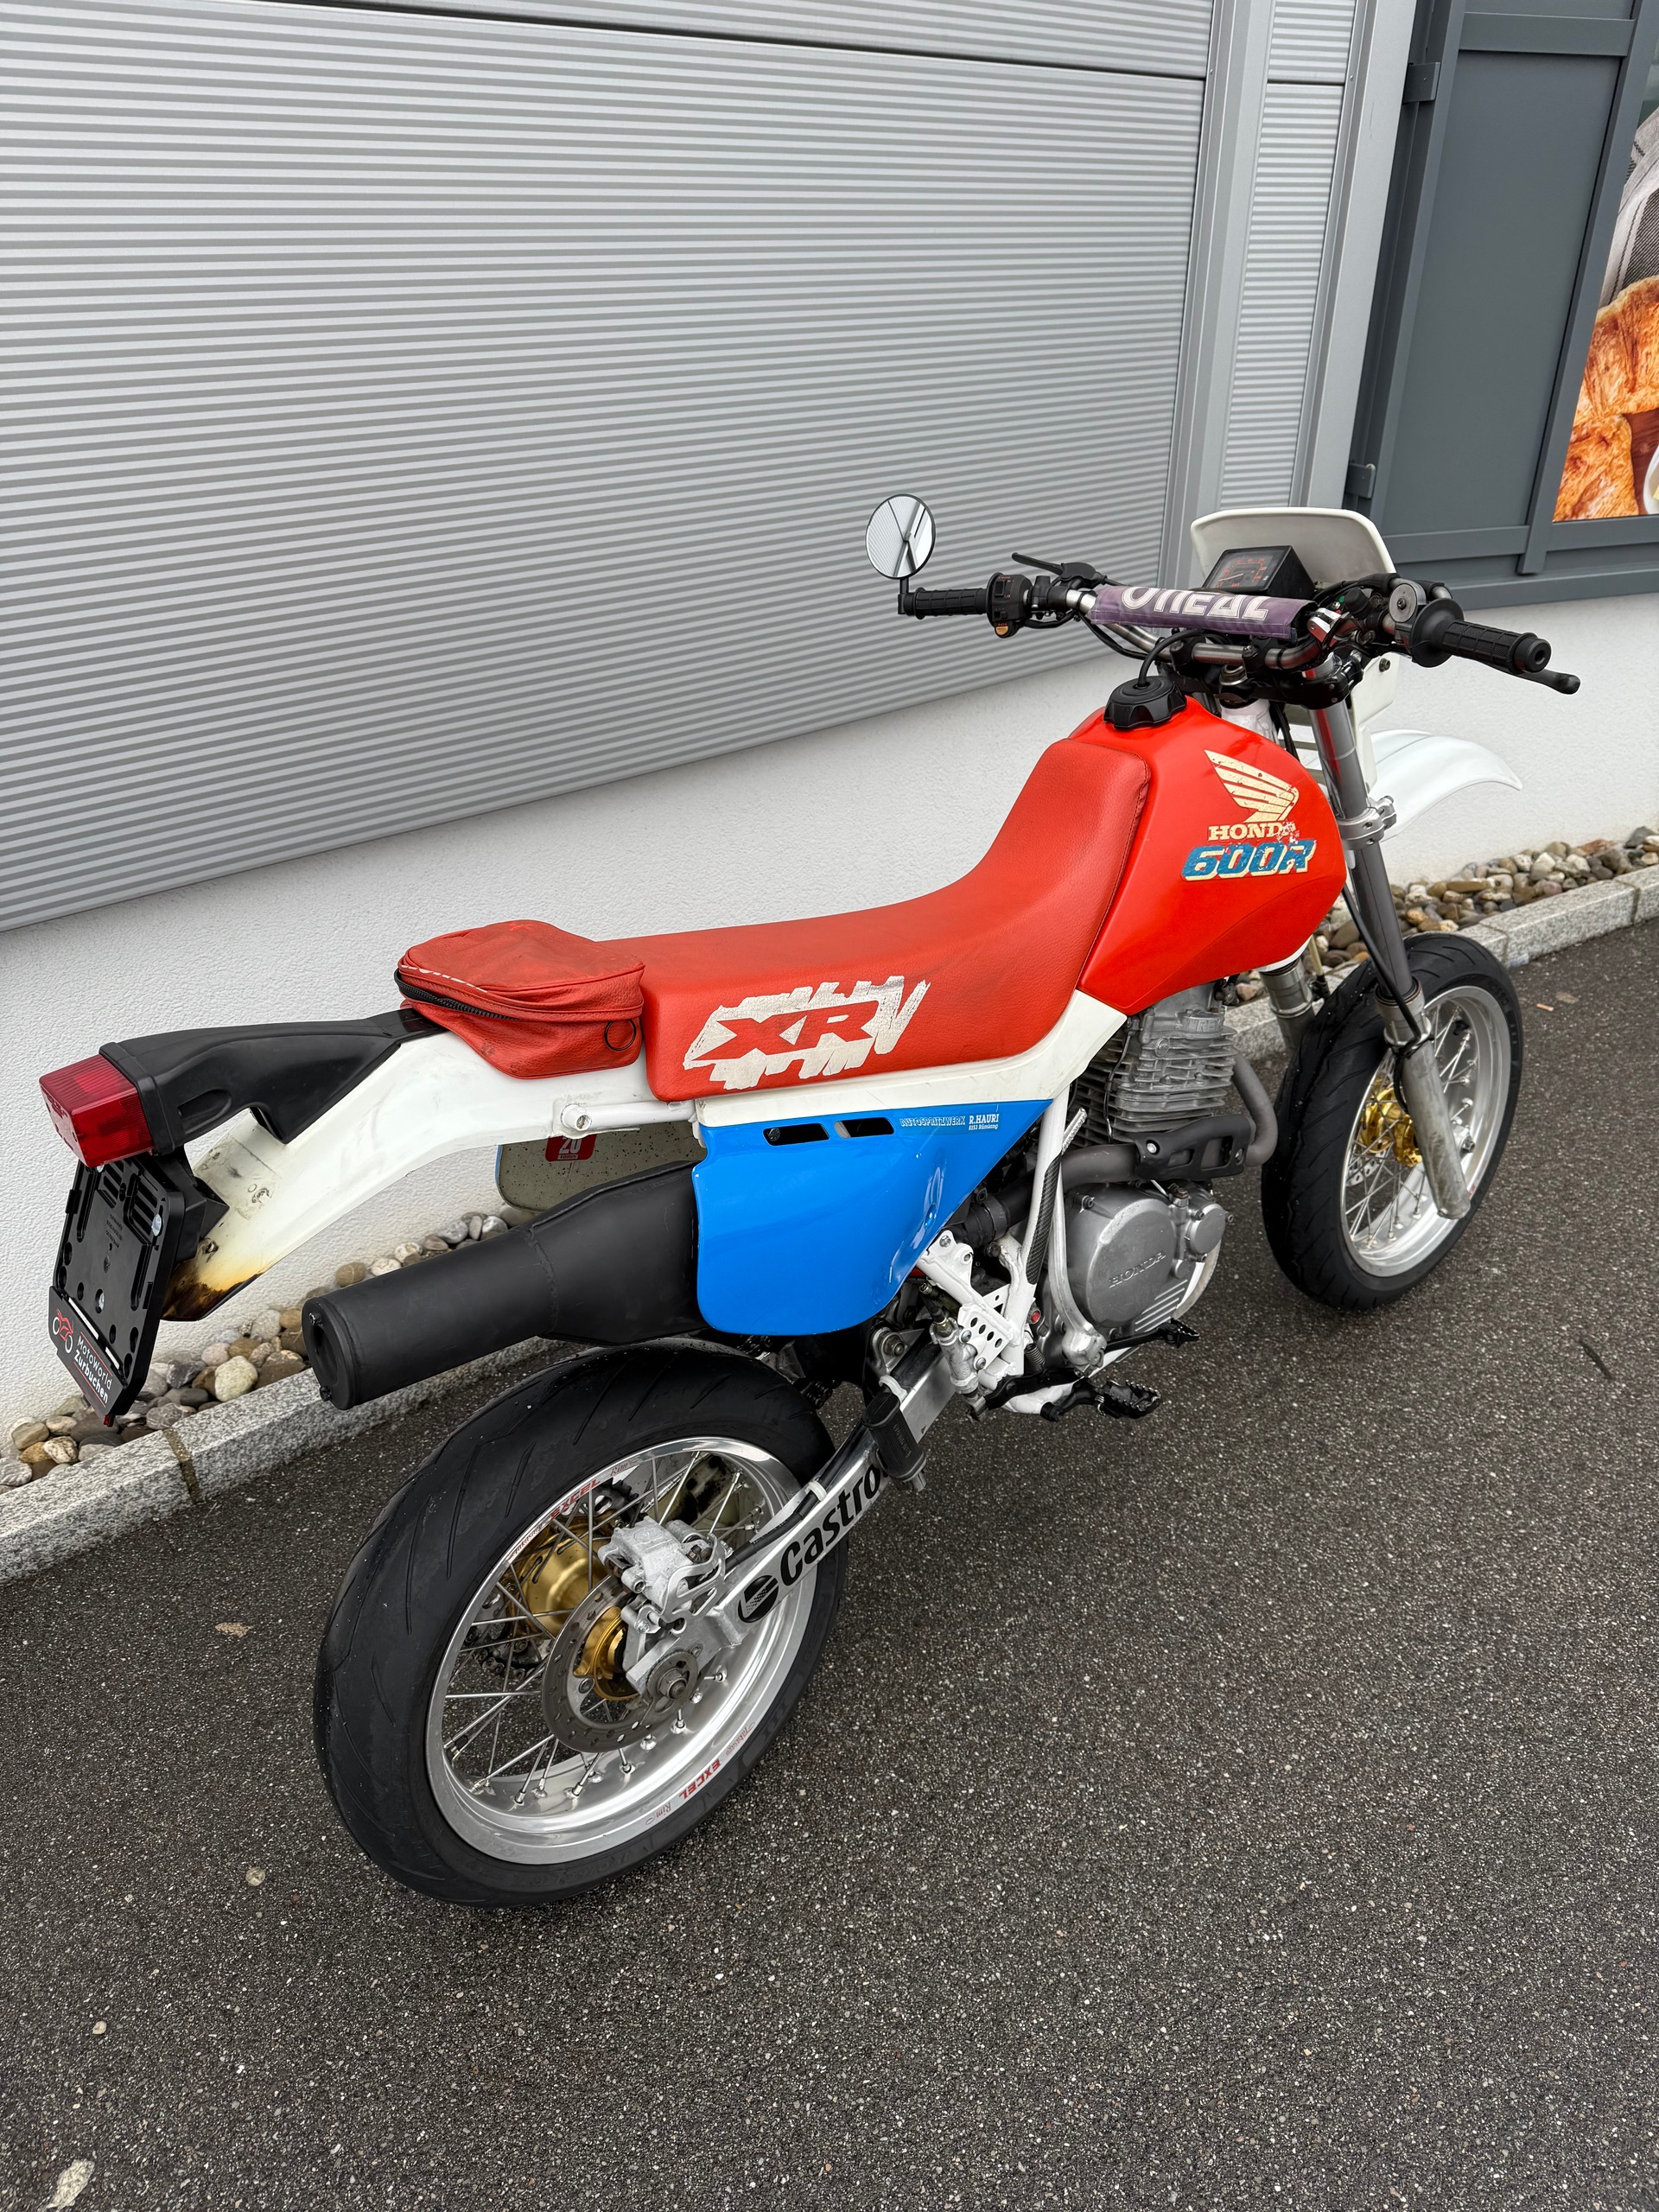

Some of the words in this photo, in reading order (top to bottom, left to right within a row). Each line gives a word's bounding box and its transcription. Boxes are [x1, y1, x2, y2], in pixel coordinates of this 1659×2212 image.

[1181, 839, 1318, 881] 600R
[969, 1113, 1000, 1125] R.HAURI
[1109, 1250, 1167, 1289] HONDA
[73, 1349, 109, 1405] Zurbuchen
[550, 1478, 601, 1520] EXCEL
[780, 1463, 889, 1587] Castro
[678, 1758, 721, 1800] EXCEL
